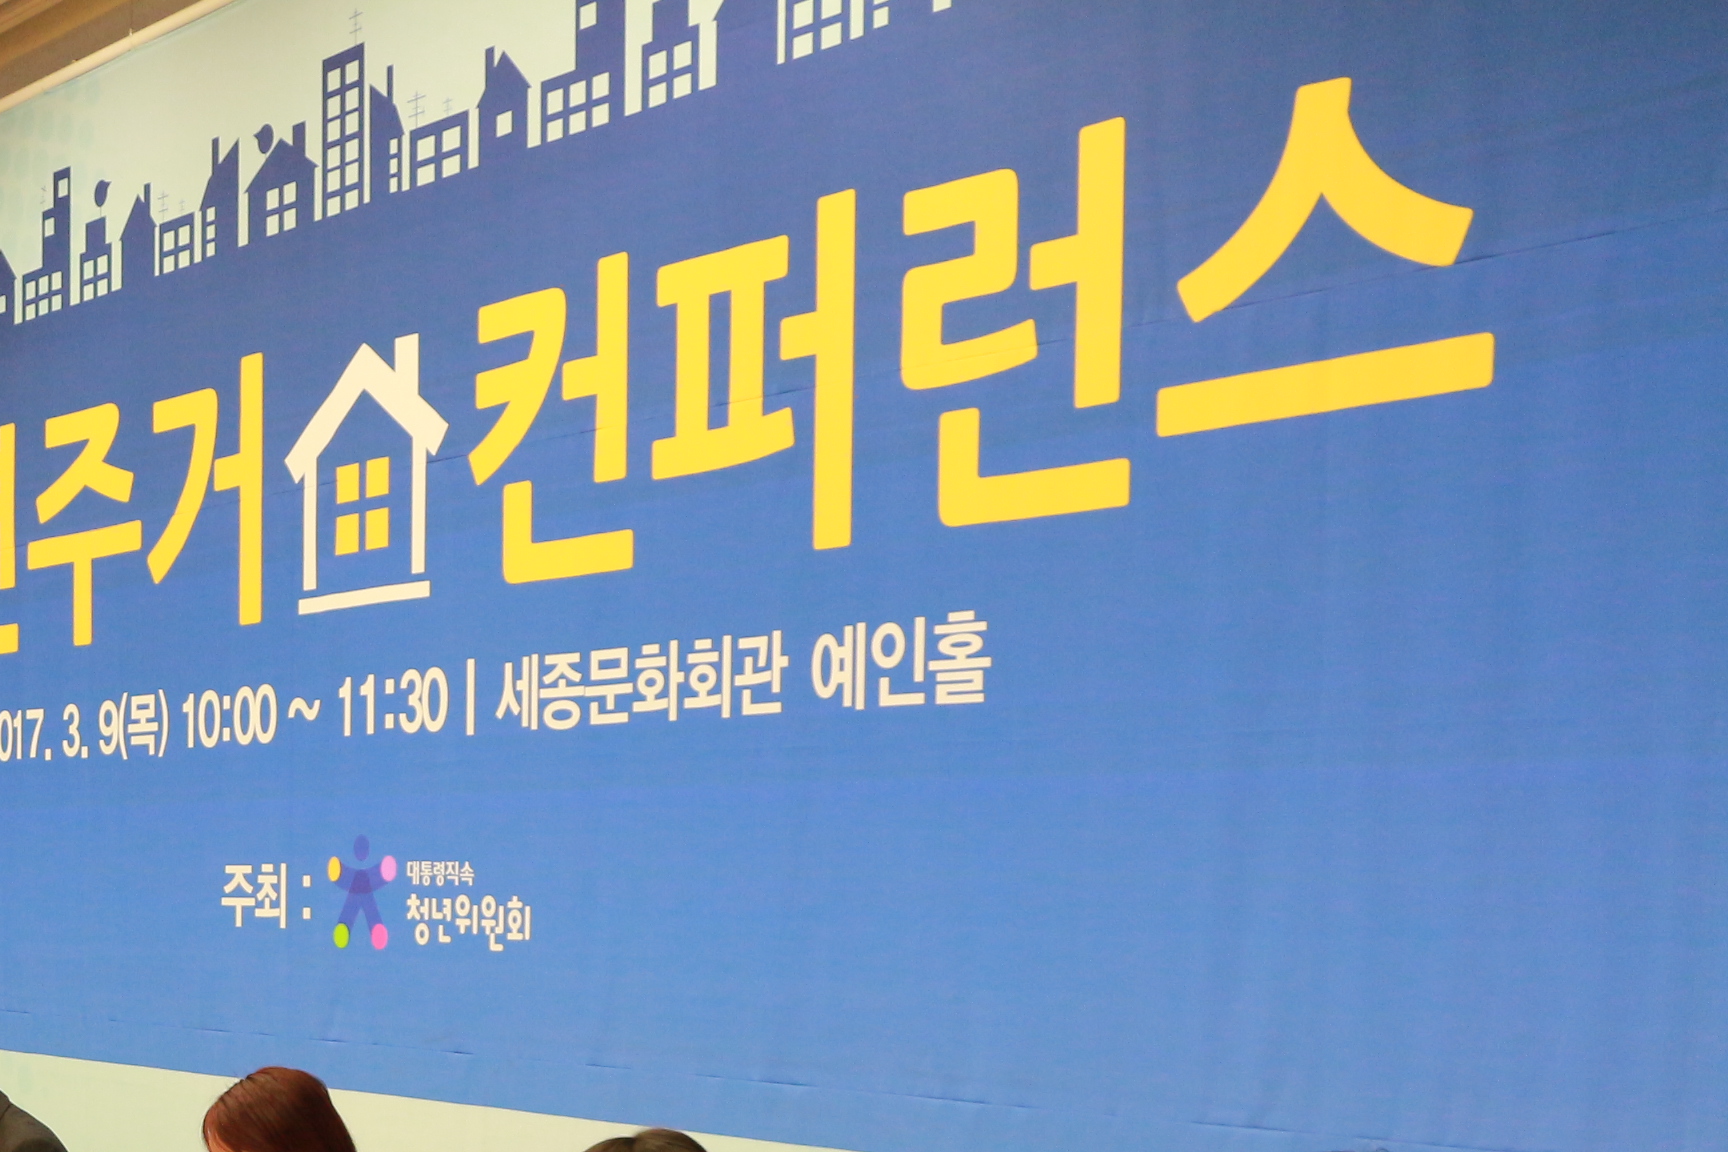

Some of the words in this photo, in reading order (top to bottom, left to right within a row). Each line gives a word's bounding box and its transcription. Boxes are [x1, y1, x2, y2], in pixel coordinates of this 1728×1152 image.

[467, 76, 1495, 586] 컨퍼런스
[63, 703, 90, 760] 3.
[98, 688, 170, 758] 9(목)
[182, 683, 278, 750] 10:00
[337, 666, 450, 738] 11:30
[495, 630, 789, 732] 세종문화회관
[811, 609, 992, 712] 예인홀
[221, 862, 287, 929] 주최
[405, 859, 475, 887] 대통령직속
[405, 892, 531, 952] 청년위원회
